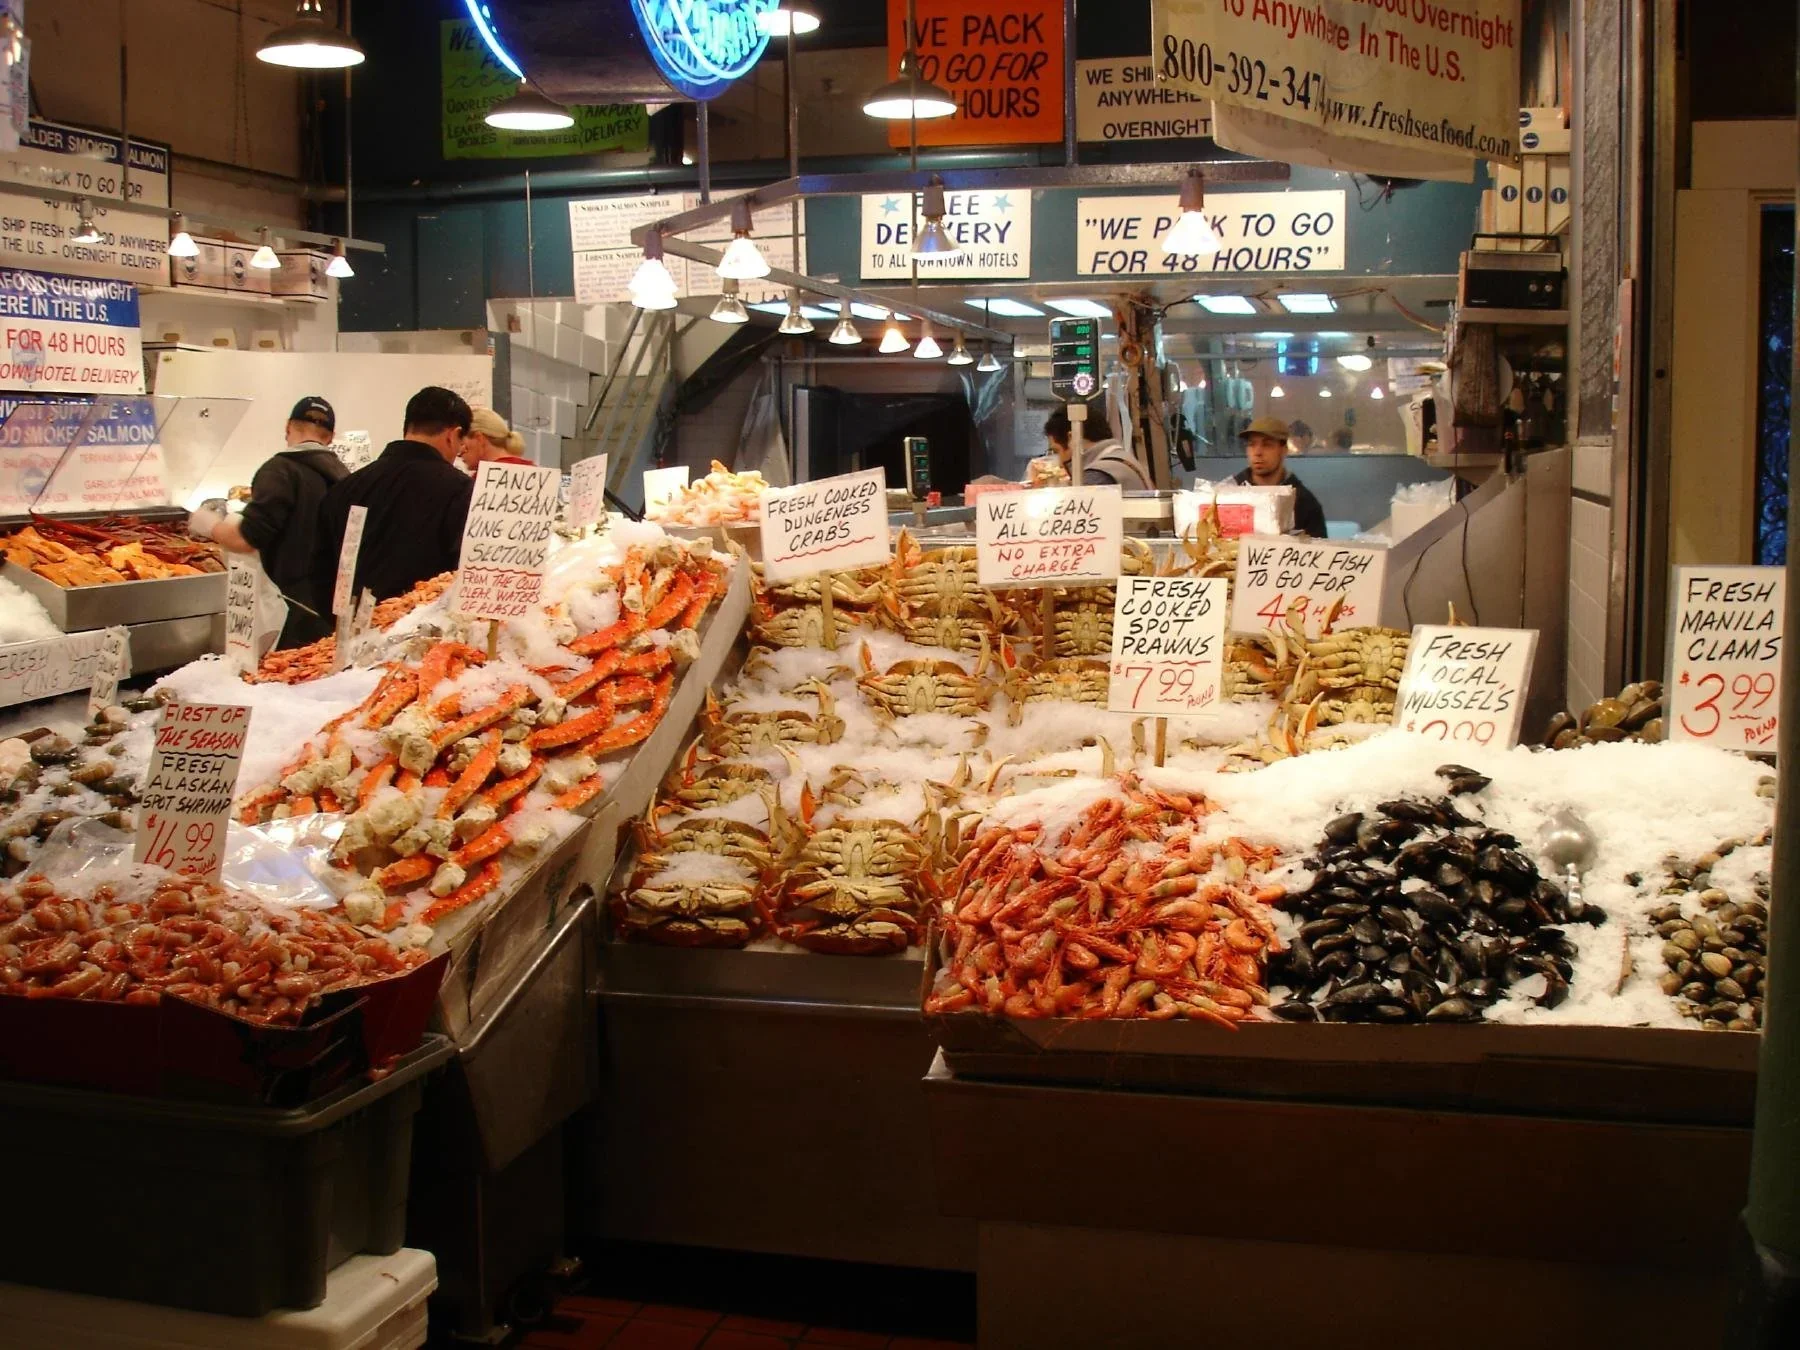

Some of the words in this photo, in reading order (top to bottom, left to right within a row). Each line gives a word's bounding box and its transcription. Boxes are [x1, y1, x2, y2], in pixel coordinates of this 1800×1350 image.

[963, 12, 1044, 46] PACK
[1412, 0, 1513, 49] Overnight
[1253, 0, 1349, 50] Anywhere
[1360, 22, 1378, 57] In
[1385, 30, 1420, 70] The
[1426, 44, 1465, 82] U.S.
[945, 53, 986, 83] GO
[990, 51, 1049, 81] FOR
[1086, 69, 1113, 85] WE
[1122, 67, 1153, 83] SHI
[585, 118, 642, 143] DELIVERY
[1103, 118, 1212, 139] OVERNIGHT
[128, 149, 165, 169] ALMON
[76, 172, 92, 190] TO
[98, 177, 115, 194] GO
[2, 217, 26, 232] SHIP
[31, 221, 65, 239] FRESH
[120, 235, 167, 253] ANYWHERE
[1241, 213, 1276, 238] TO
[1291, 212, 1334, 237] GO
[3, 236, 22, 252] THE
[62, 244, 117, 265] OVERNIGHT
[121, 253, 162, 269] DELIVERY
[872, 254, 884, 268] TO
[889, 253, 907, 267] ALL
[979, 253, 1019, 268] HOTELS
[1091, 250, 1149, 274] FOR
[52, 277, 133, 302] OVERNIGHT
[32, 296, 49, 316] IN
[51, 298, 82, 319] THE
[86, 303, 109, 322] U.S.
[6, 328, 42, 351] FOR
[48, 331, 68, 352] 48
[73, 333, 125, 356] HOURS
[33, 366, 78, 381] HOTEL
[81, 367, 139, 384] DELIVERY
[87, 424, 155, 443] SALMON
[484, 467, 551, 496] FANCY
[471, 492, 556, 516] ALASKAN
[767, 492, 816, 519] FRESH
[824, 480, 878, 505] COOKED
[783, 499, 871, 533] DUNGENESS
[988, 502, 1018, 522] WE
[467, 516, 504, 538] KING
[508, 520, 552, 543] CRAB
[996, 522, 1027, 539] ALL
[467, 543, 546, 567] SECTIONS
[998, 548, 1025, 562] NO
[1040, 544, 1095, 559] EXTRA
[1248, 546, 1275, 566] WE
[1279, 548, 1320, 569] PACK
[1328, 551, 1374, 573] FISH
[1011, 557, 1083, 577] CHARGE
[462, 570, 488, 585] FROM
[492, 574, 513, 588] THE
[516, 576, 541, 591] COLD
[1132, 580, 1211, 598] FRESH
[1248, 569, 1273, 589] TO
[1278, 572, 1303, 588] GO
[1309, 575, 1357, 593] FOR
[1688, 577, 1776, 603] FRESH
[459, 586, 491, 599] CLEAR
[496, 590, 541, 603] WATERS
[460, 601, 476, 612] OF
[478, 602, 528, 616] ALASKA
[1121, 598, 1211, 617] COOKED
[1130, 617, 1194, 636] SPOT
[1680, 609, 1774, 634] MANILA
[1121, 635, 1215, 656] PRAWNS
[1422, 635, 1512, 662] FRESH
[1688, 636, 1782, 661] CLAMS
[165, 704, 218, 721] FIRST
[221, 707, 246, 723] OF
[156, 726, 185, 746] THE
[186, 730, 245, 750] SEASON
[1744, 717, 1777, 744] POUND
[162, 756, 225, 776] FRESH
[149, 775, 236, 794] ALASKAN
[142, 794, 176, 808] SPOT
[176, 797, 232, 815] SHRIMP
